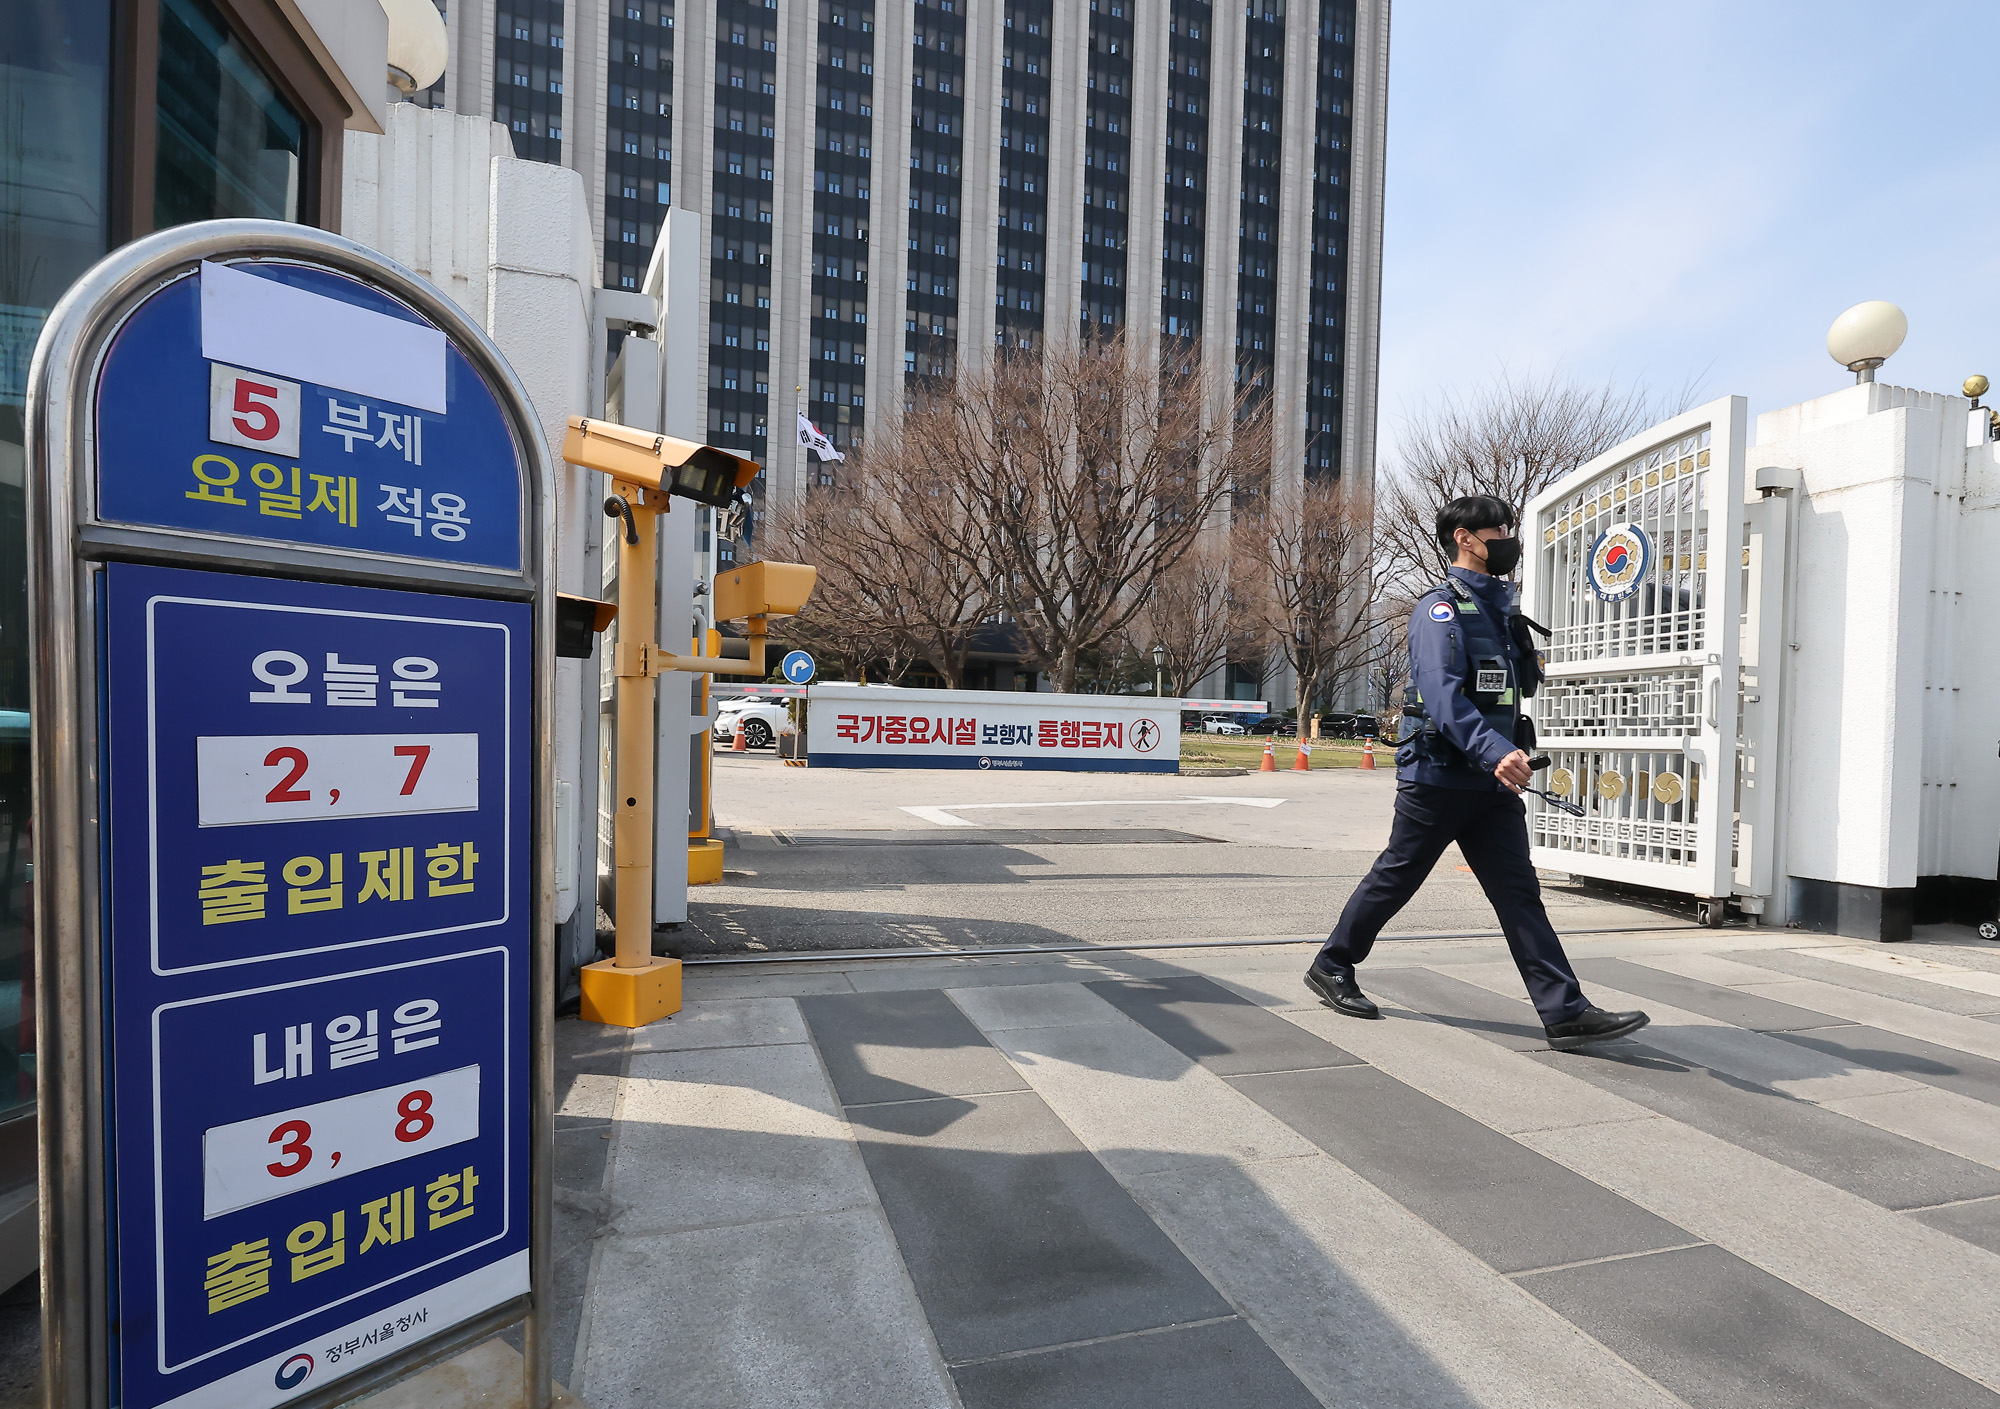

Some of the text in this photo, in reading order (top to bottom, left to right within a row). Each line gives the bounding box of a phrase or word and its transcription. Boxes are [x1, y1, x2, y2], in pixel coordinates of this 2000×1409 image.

[232, 378, 423, 466] 5 부제
[185, 454, 471, 542] 요일제 적용
[249, 650, 442, 708] 오늘은
[836, 714, 1123, 750] 국가중요시설 보행자 통행금지
[394, 745, 431, 796] 7
[198, 841, 480, 926] 출입제한
[253, 998, 442, 1085] 내일은
[394, 1089, 435, 1143] 8
[204, 1165, 480, 1315] 출입제한
[325, 1306, 429, 1364] 정부서울청사
